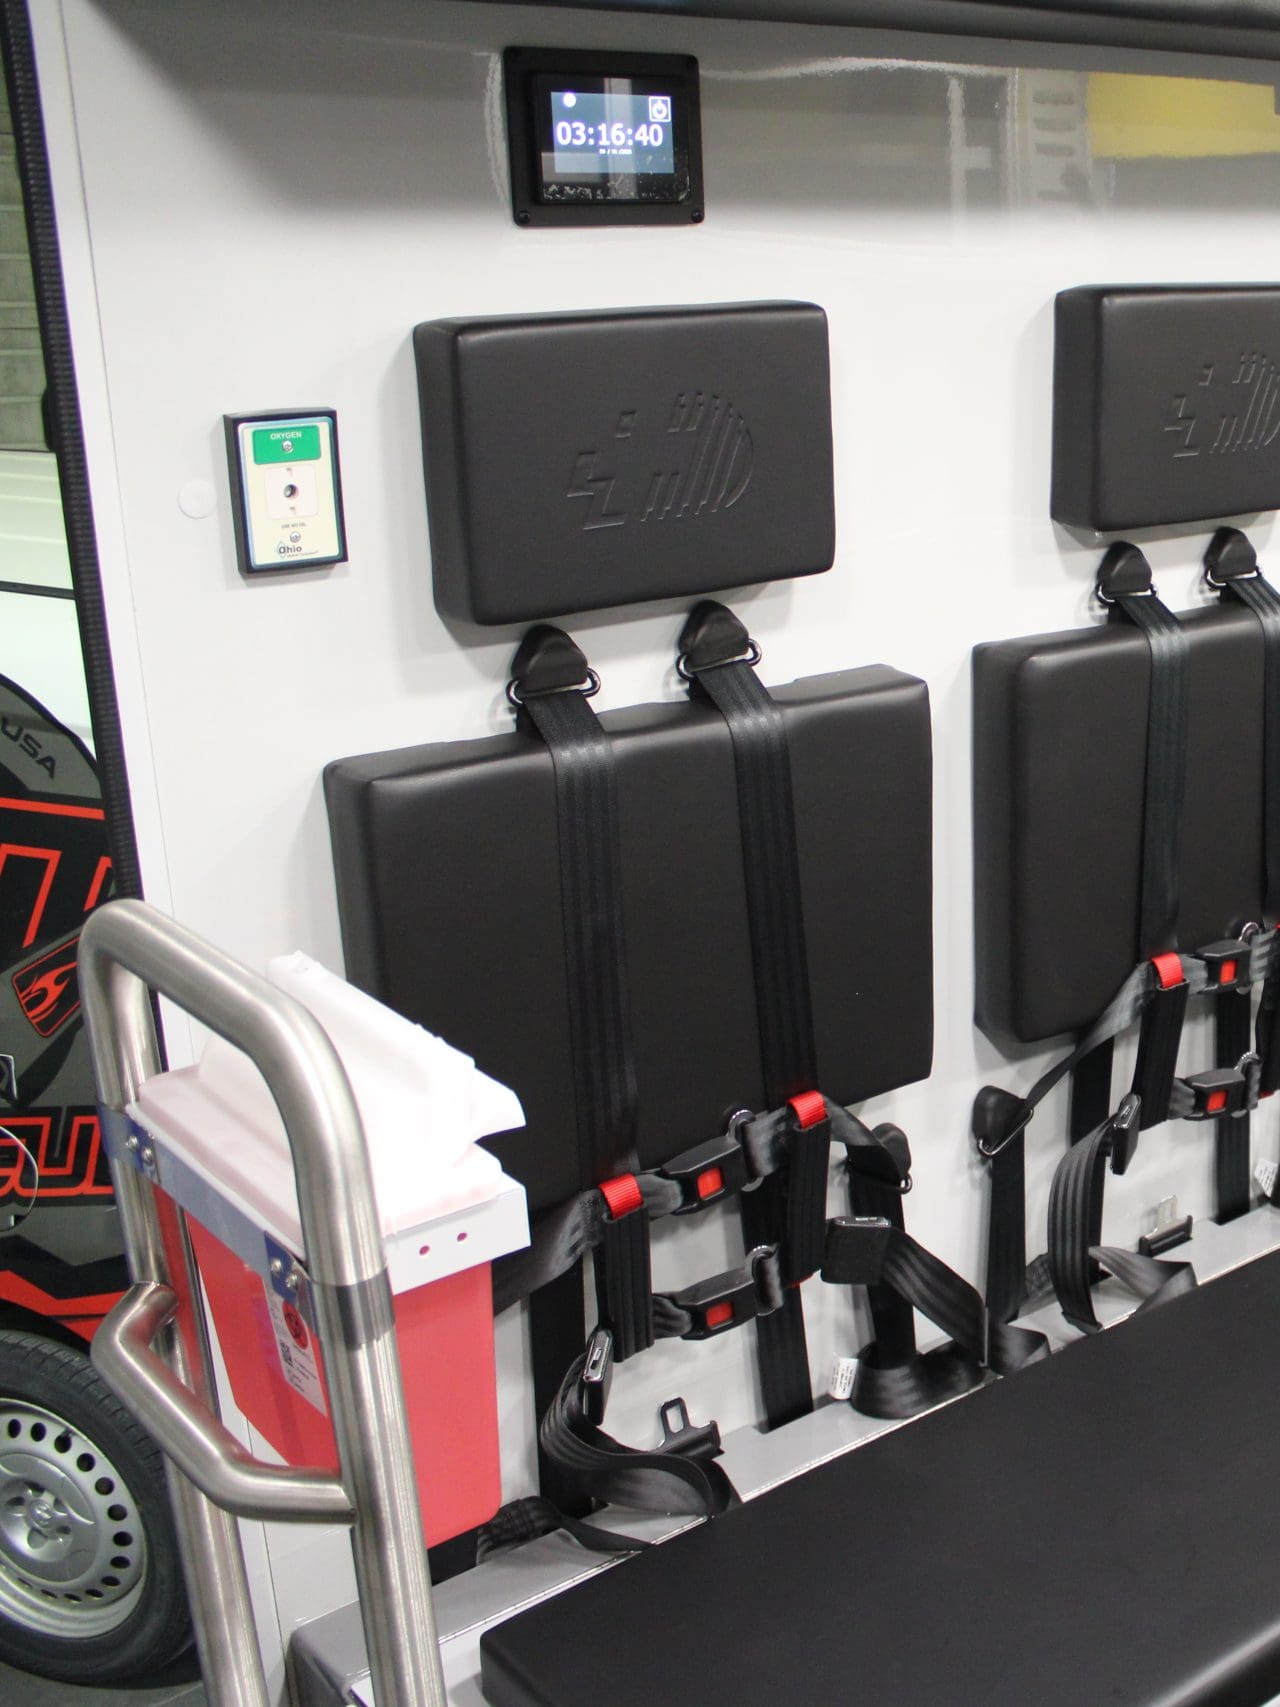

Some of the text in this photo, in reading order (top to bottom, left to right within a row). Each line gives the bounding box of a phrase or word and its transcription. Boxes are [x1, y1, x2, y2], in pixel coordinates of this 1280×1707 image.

[556, 121, 663, 146] 03:16:40
[270, 431, 302, 440] OXYGEN
[1, 717, 56, 779] USA
